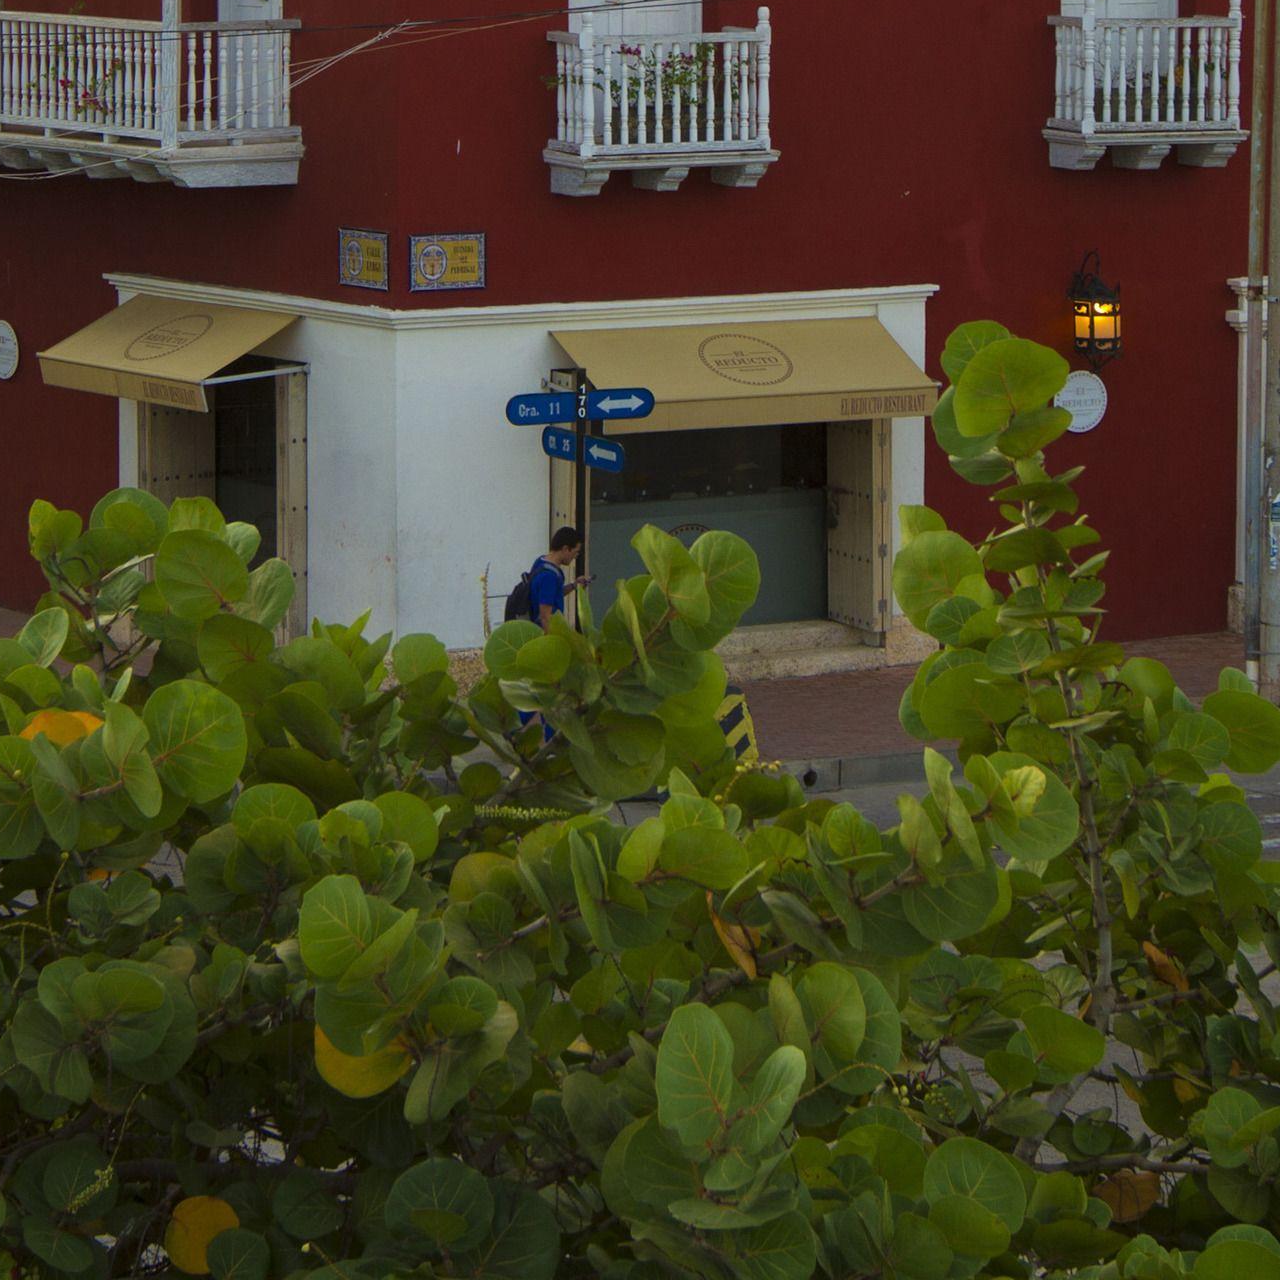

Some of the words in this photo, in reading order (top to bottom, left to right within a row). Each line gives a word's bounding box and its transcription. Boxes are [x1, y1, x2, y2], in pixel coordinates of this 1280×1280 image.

[714, 356, 778, 367] REDUCTO
[577, 383, 587, 419] 170
[840, 398, 848, 416] EL
[850, 396, 882, 415] REDUCTO
[518, 403, 540, 418] Cra.
[549, 402, 560, 415] 11
[562, 438, 570, 452] 25
